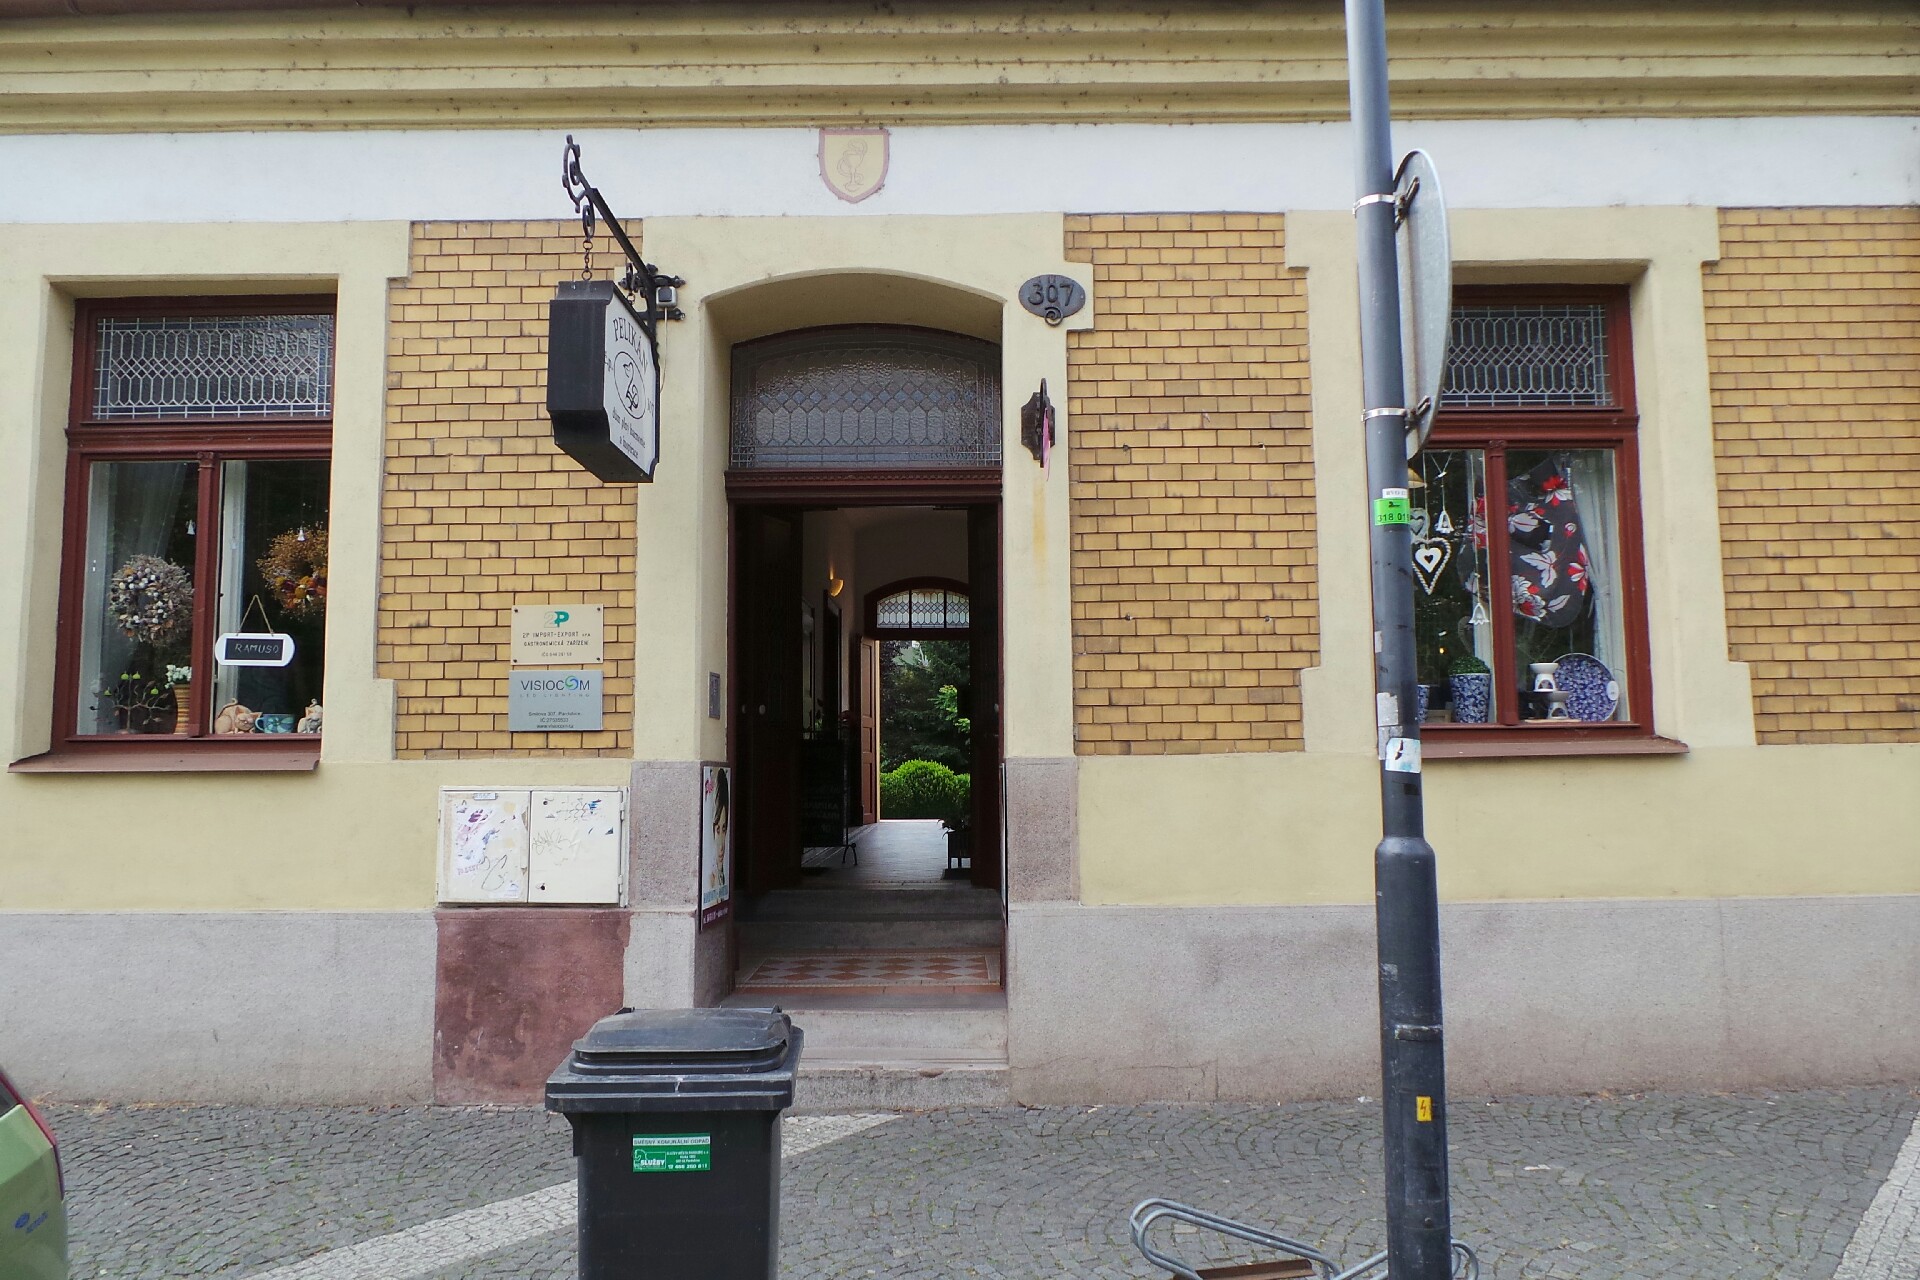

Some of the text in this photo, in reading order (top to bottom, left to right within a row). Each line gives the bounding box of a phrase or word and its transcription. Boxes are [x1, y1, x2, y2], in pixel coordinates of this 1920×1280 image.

[1028, 282, 1075, 307] 307
[613, 317, 648, 375] PELIKÁN
[235, 643, 280, 654] RAMUSO
